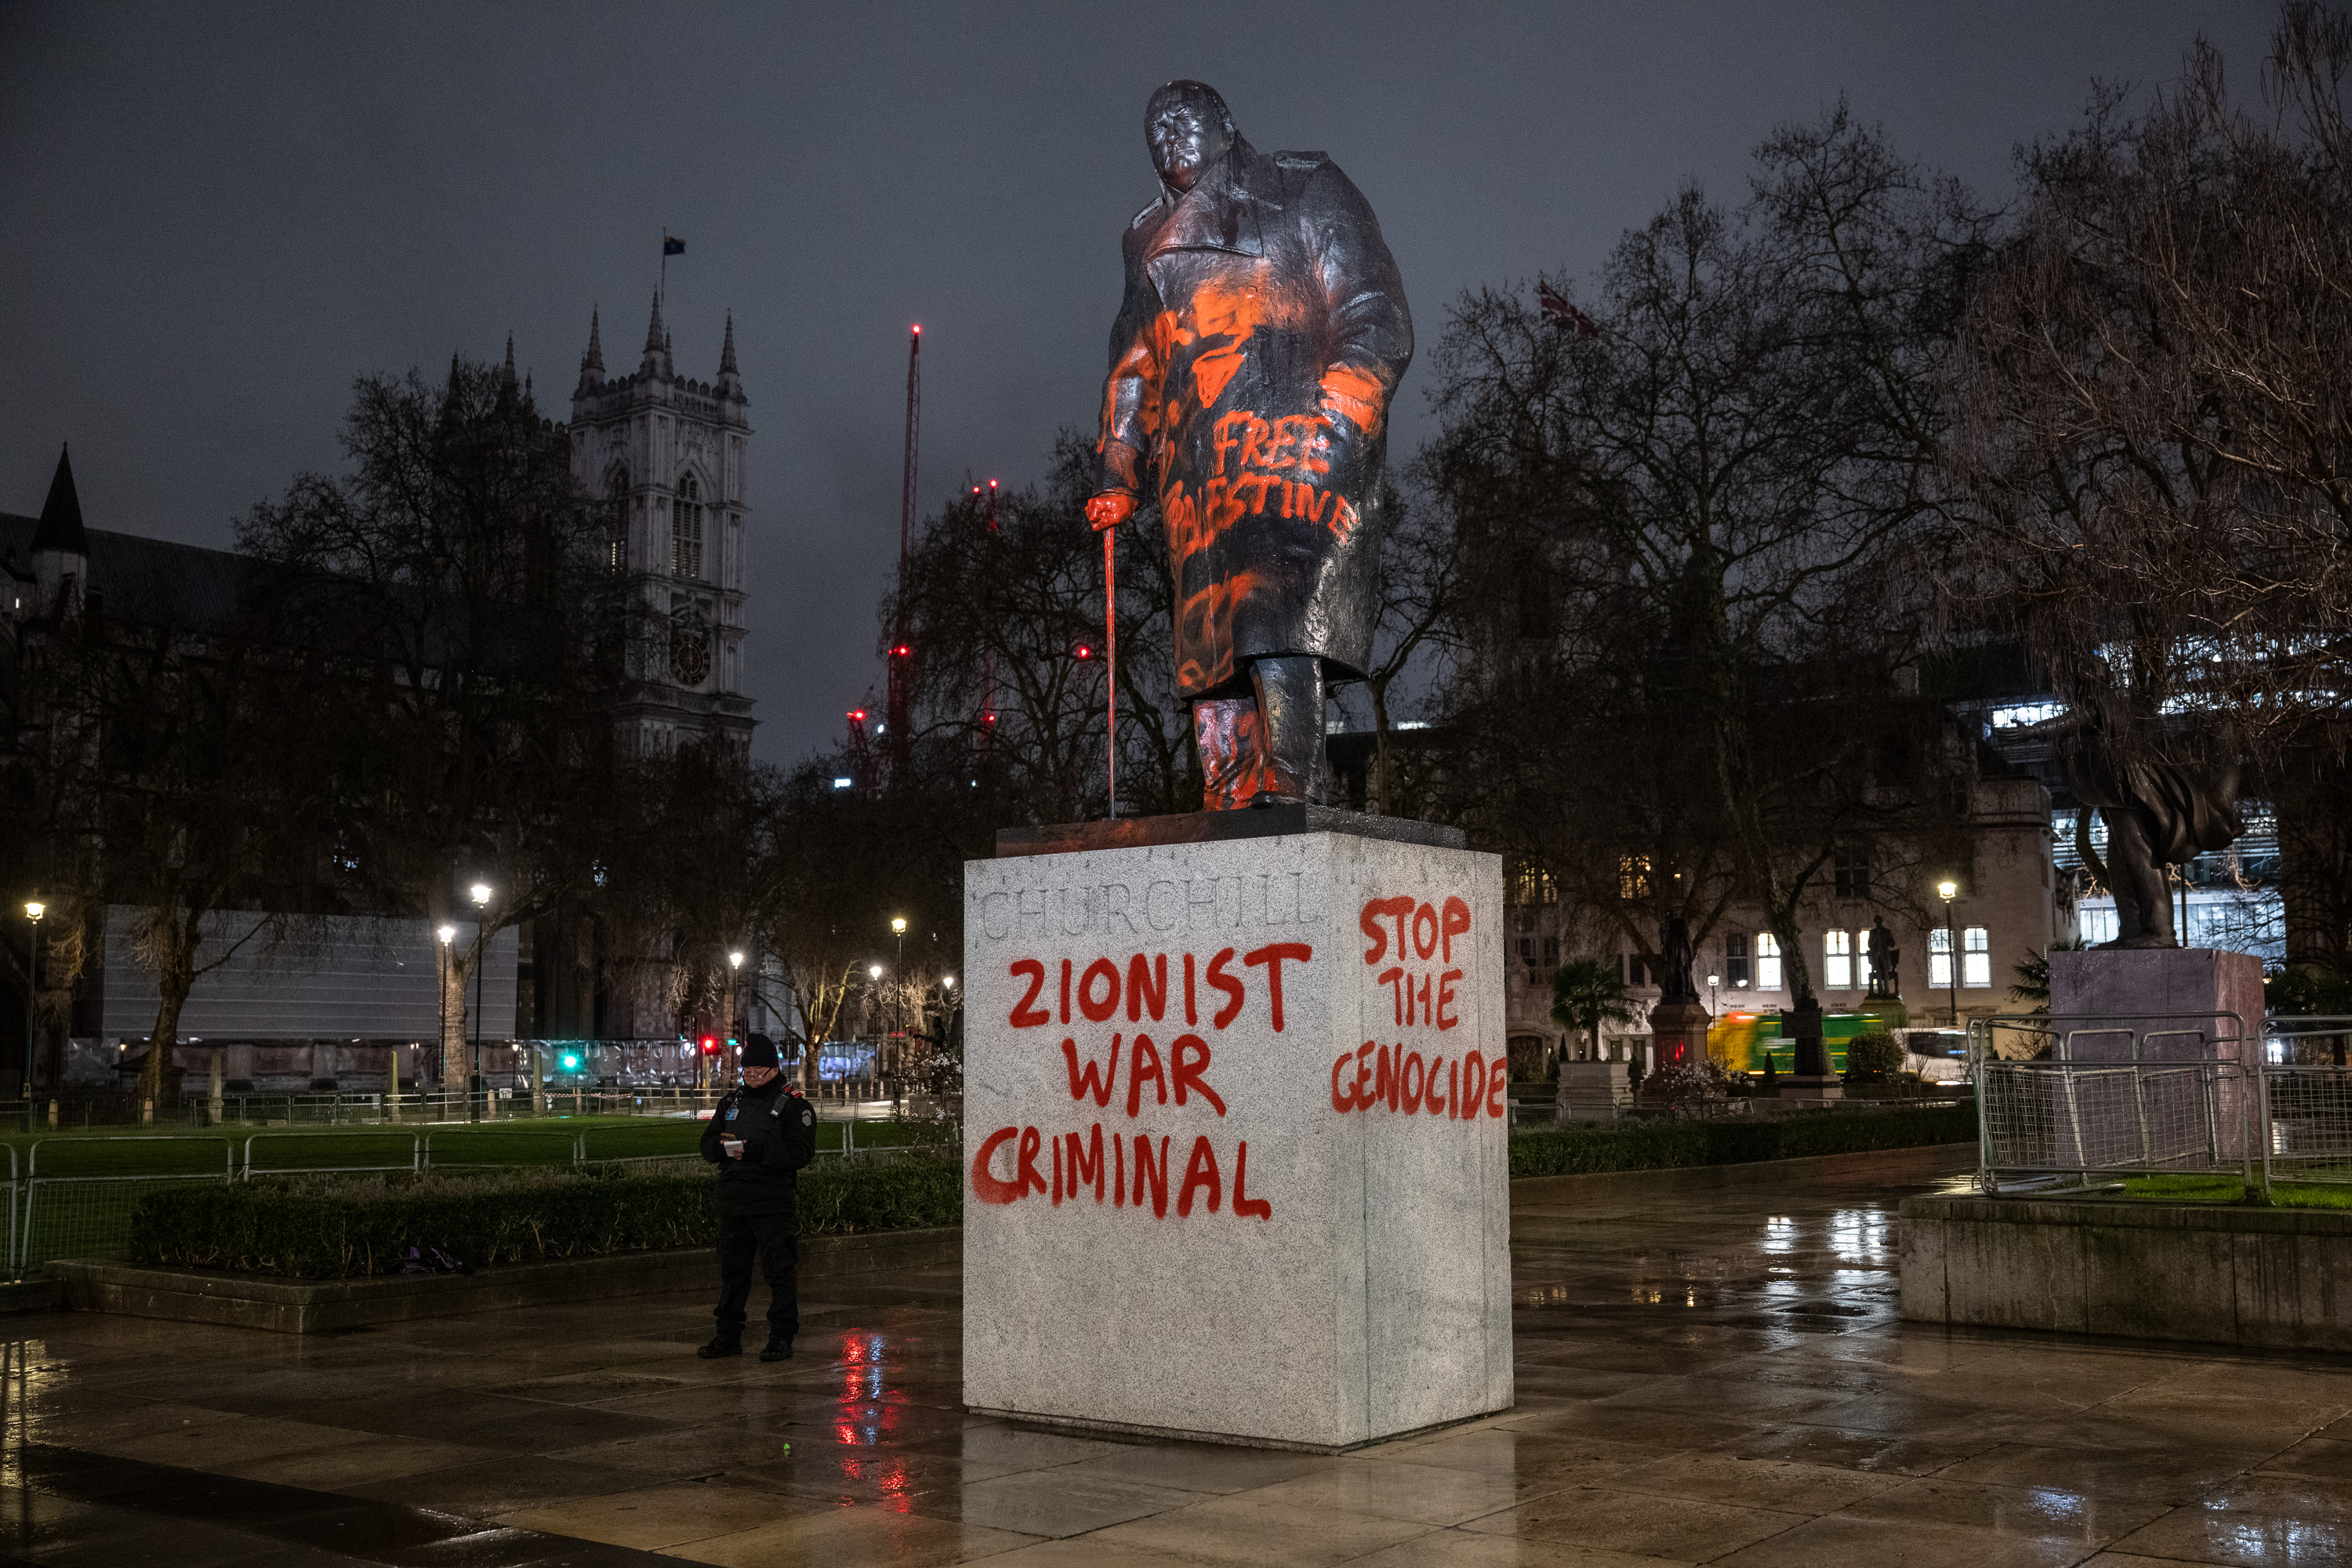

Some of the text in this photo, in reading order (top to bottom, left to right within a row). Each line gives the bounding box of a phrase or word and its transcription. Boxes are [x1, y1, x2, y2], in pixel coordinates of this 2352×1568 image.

[1213, 411, 1332, 474] FREE
[982, 871, 1319, 940] CHURCHILL
[1360, 895, 1472, 966] STOP
[1377, 967, 1463, 1032] THE
[1061, 1033, 1227, 1119] WAR
[1331, 1040, 1507, 1120] GENOCIDE
[972, 1122, 1272, 1221] CRIMINAL
